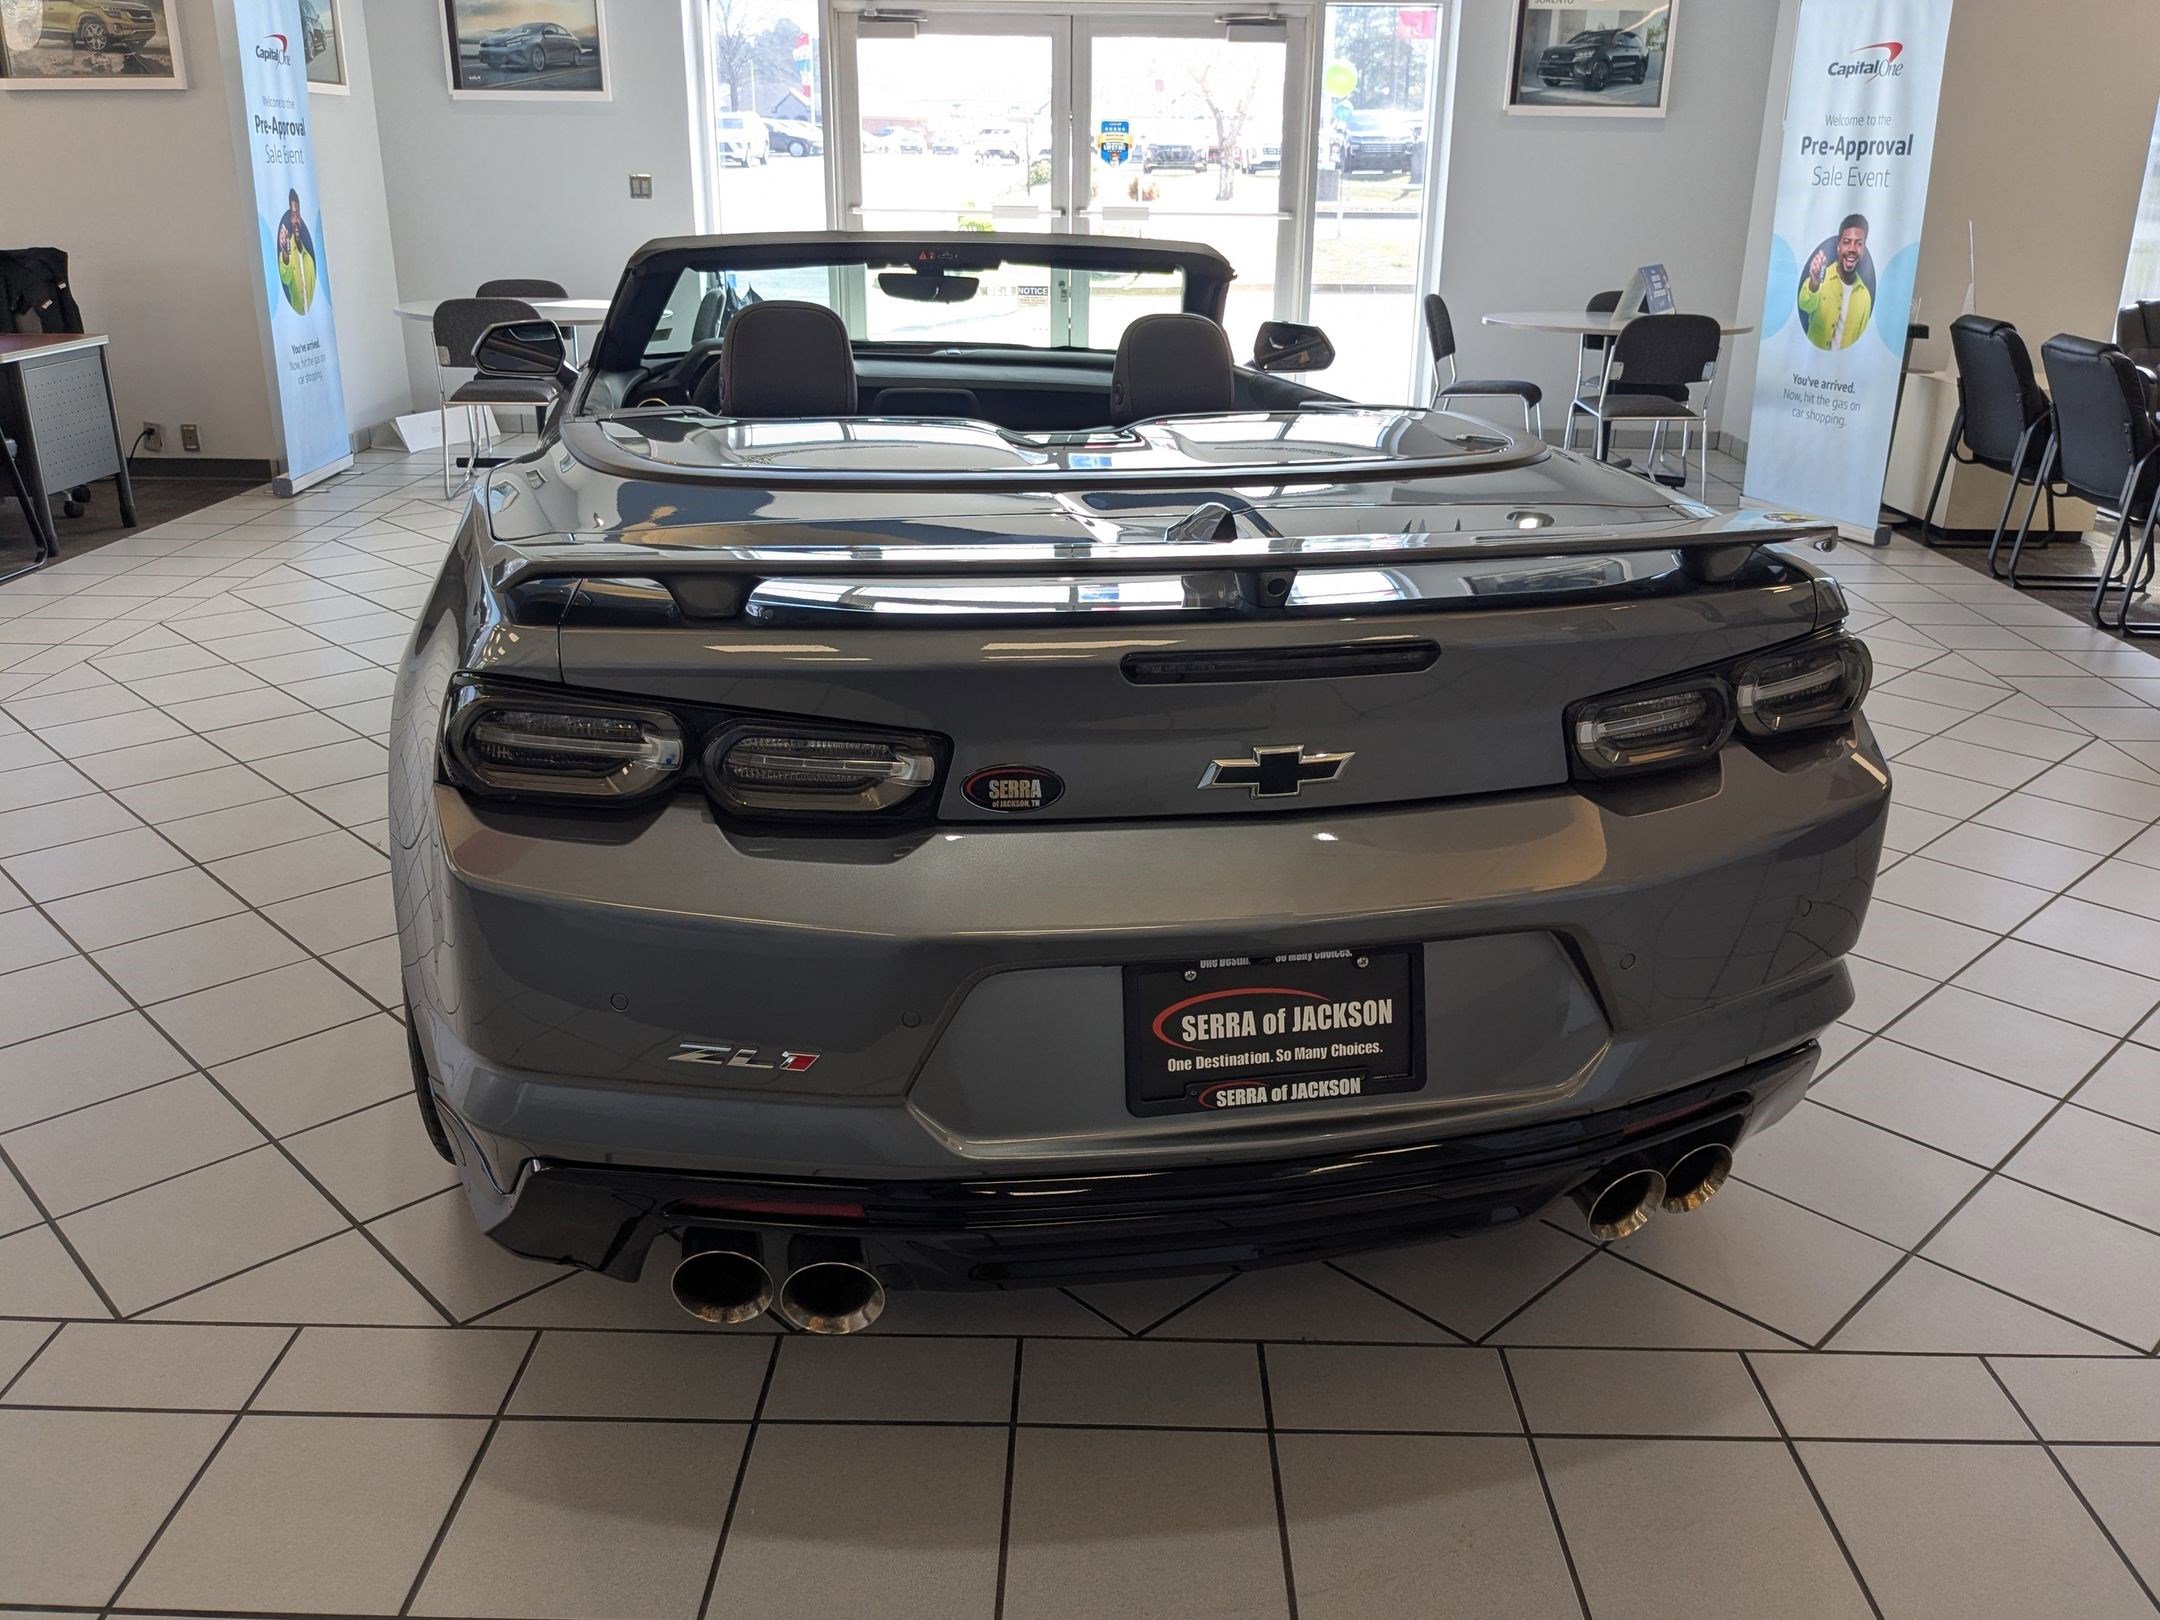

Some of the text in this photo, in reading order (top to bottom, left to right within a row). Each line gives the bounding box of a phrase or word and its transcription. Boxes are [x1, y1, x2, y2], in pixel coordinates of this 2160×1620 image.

[1827, 59, 1904, 78] Capital One
[254, 114, 306, 140] Pre-Approval
[1825, 114, 1892, 126] Welcome to the
[265, 144, 304, 164] Sale Eent
[1800, 133, 1914, 161] Pre-Approval
[1811, 166, 1890, 188] Sale Event
[1018, 287, 1048, 295] NOTICE
[1793, 373, 1855, 394] You've arrived.
[1783, 388, 1861, 412] Now, hit the gas on
[1791, 407, 1846, 429] car shopping.
[989, 779, 1042, 799] SERRA
[992, 800, 999, 808] of
[1181, 998, 1393, 1043] SERRA of JACKSON
[667, 1043, 821, 1072] ZL1
[1167, 1041, 1383, 1073] One Destination. So Many Choices.
[1216, 1077, 1361, 1108] SERRA of JACKSON
